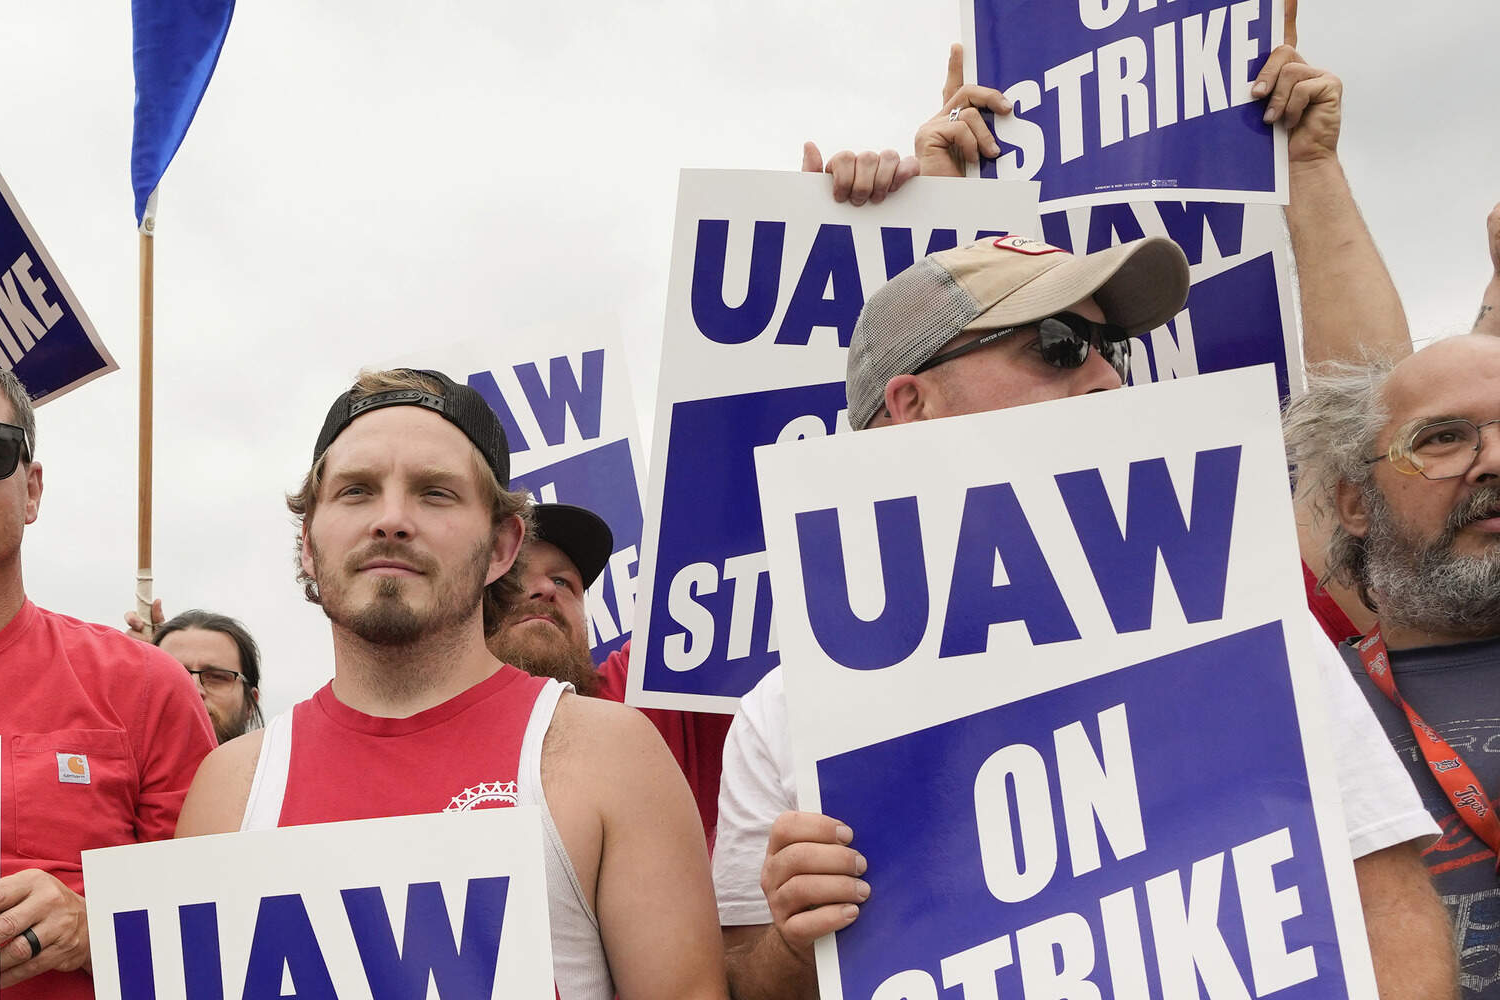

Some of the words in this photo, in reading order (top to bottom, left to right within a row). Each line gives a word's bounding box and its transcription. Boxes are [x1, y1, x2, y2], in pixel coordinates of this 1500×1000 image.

[993, 3, 1262, 181] STRIKE
[794, 444, 1243, 672] UAW
[973, 703, 1148, 905] ON
[1454, 784, 1489, 819] Tigers
